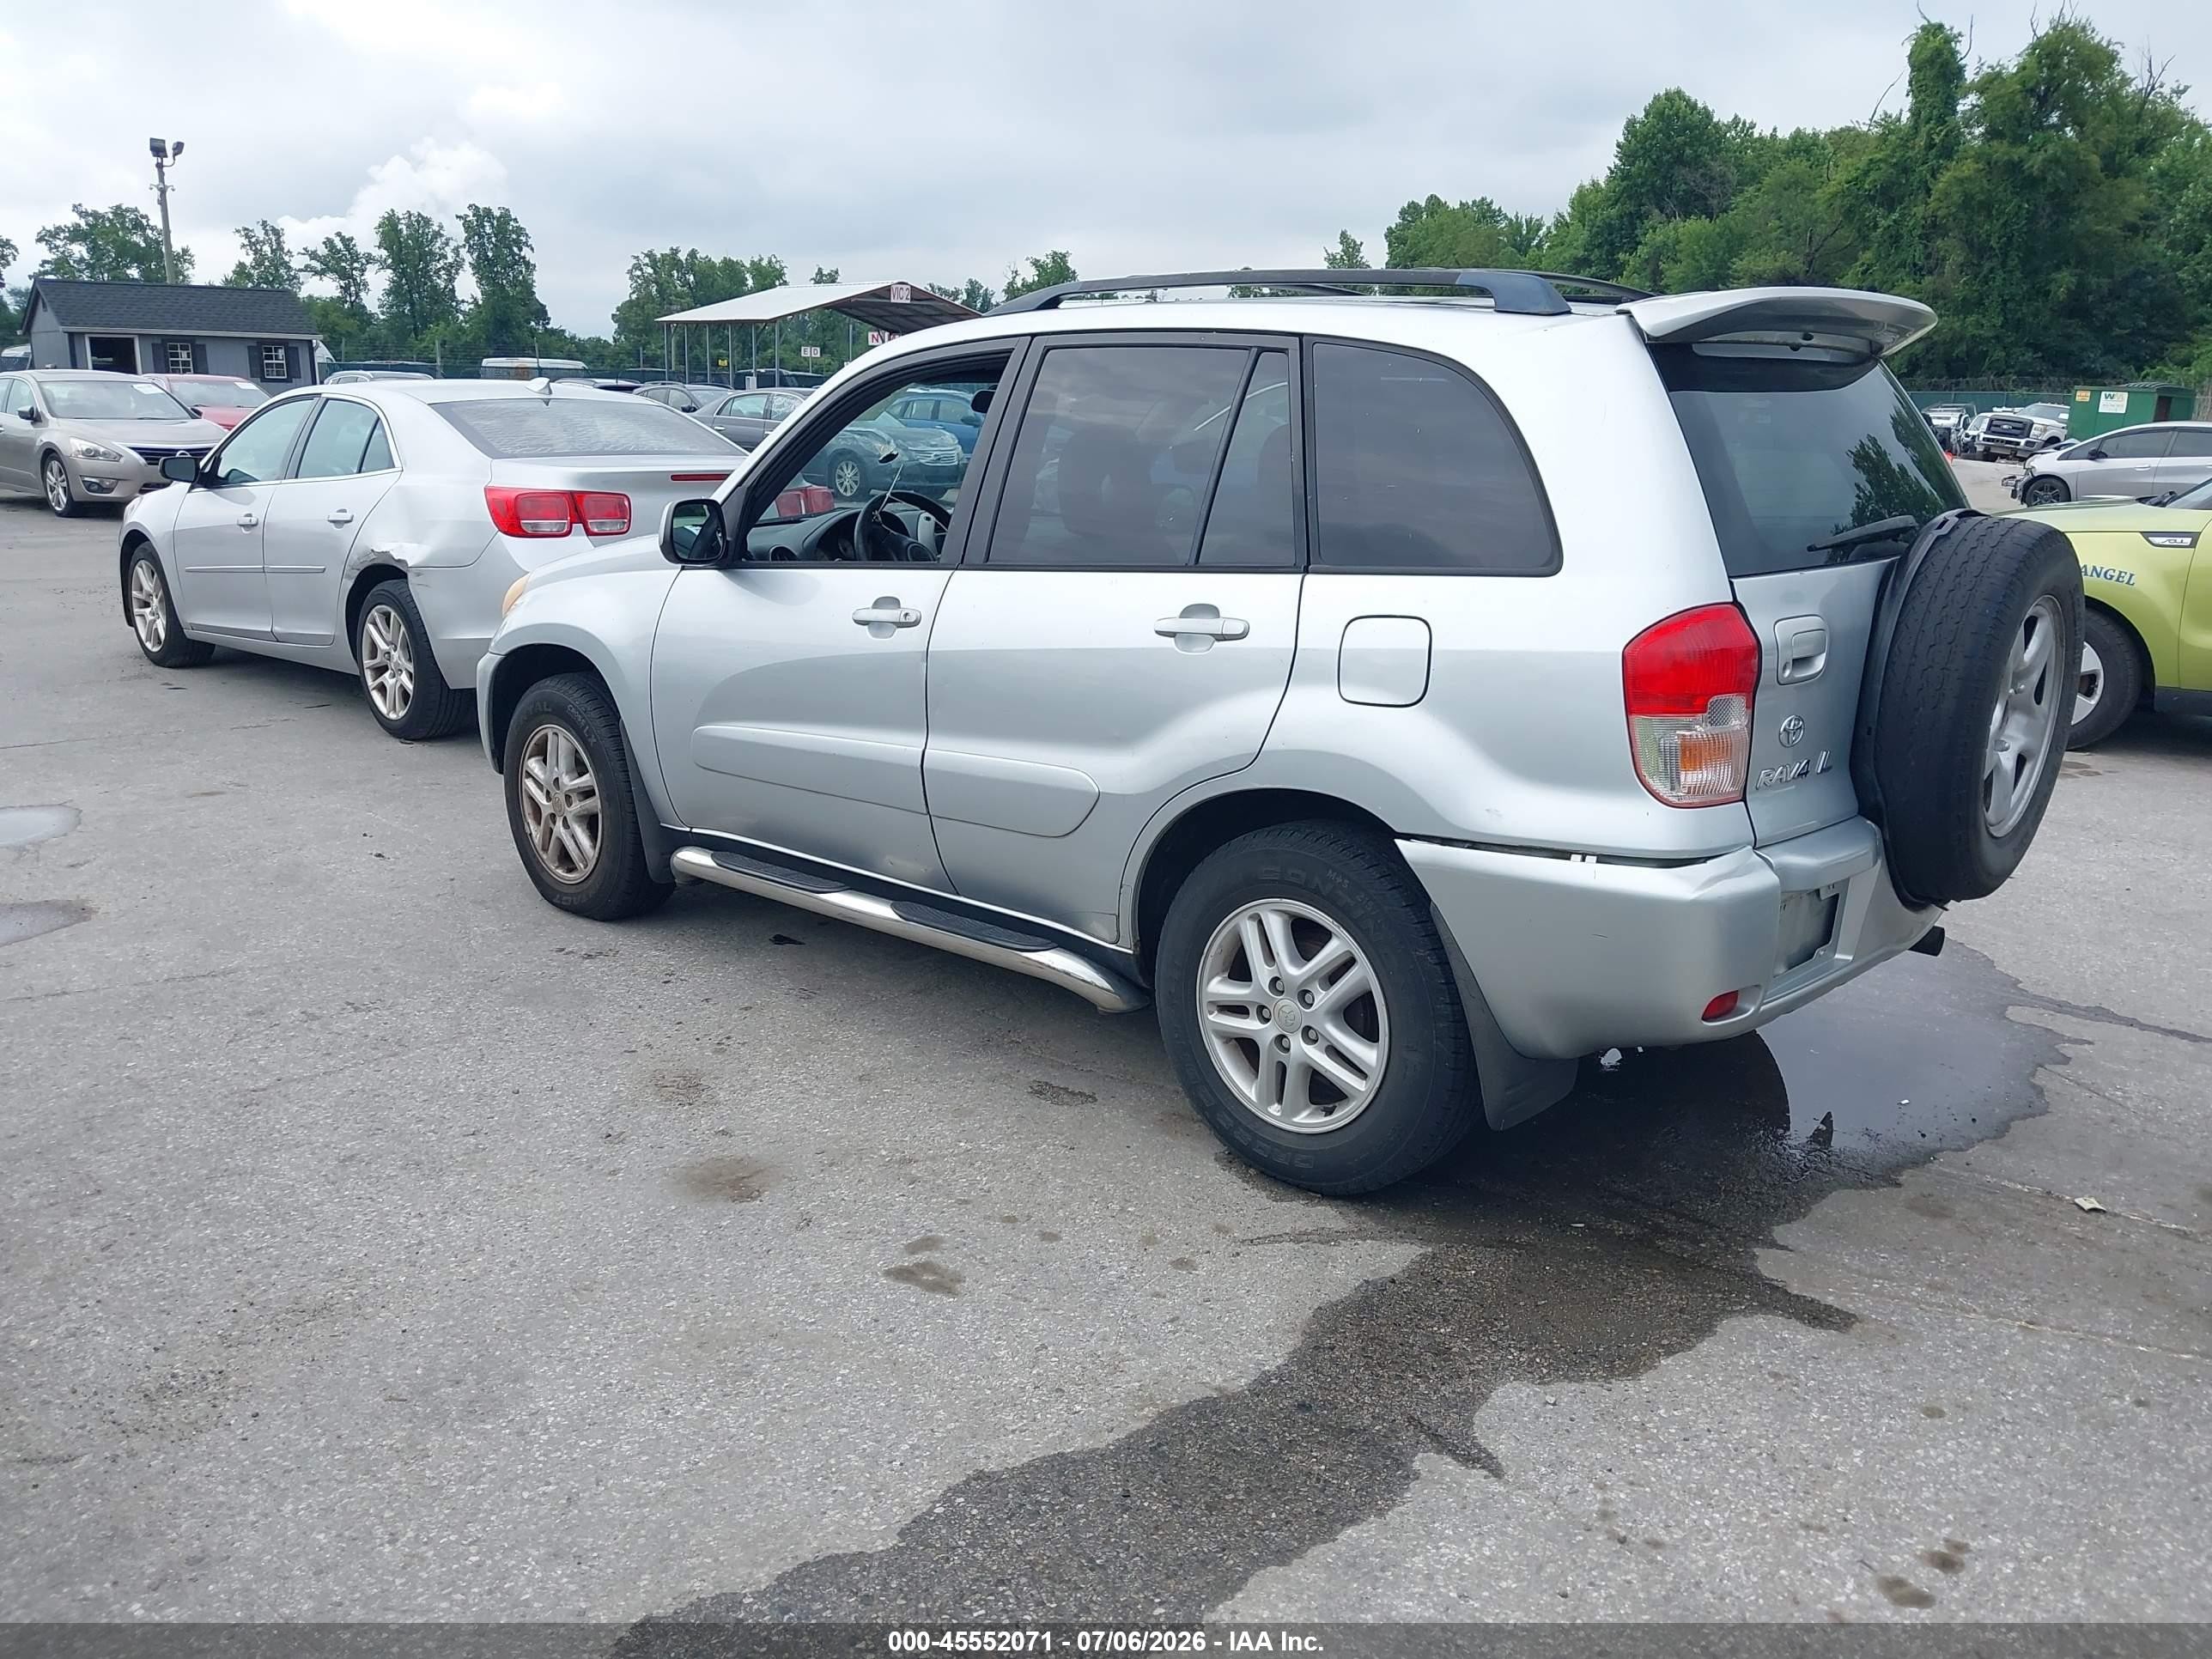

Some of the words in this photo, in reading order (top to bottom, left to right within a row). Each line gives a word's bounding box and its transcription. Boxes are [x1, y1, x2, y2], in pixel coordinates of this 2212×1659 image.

[891, 287, 904, 301] VIC
[905, 287, 910, 301] 2
[871, 333, 879, 343] N
[812, 348, 819, 356] D
[2081, 563, 2136, 586] ANGEL
[1755, 758, 1810, 790] RAV4
